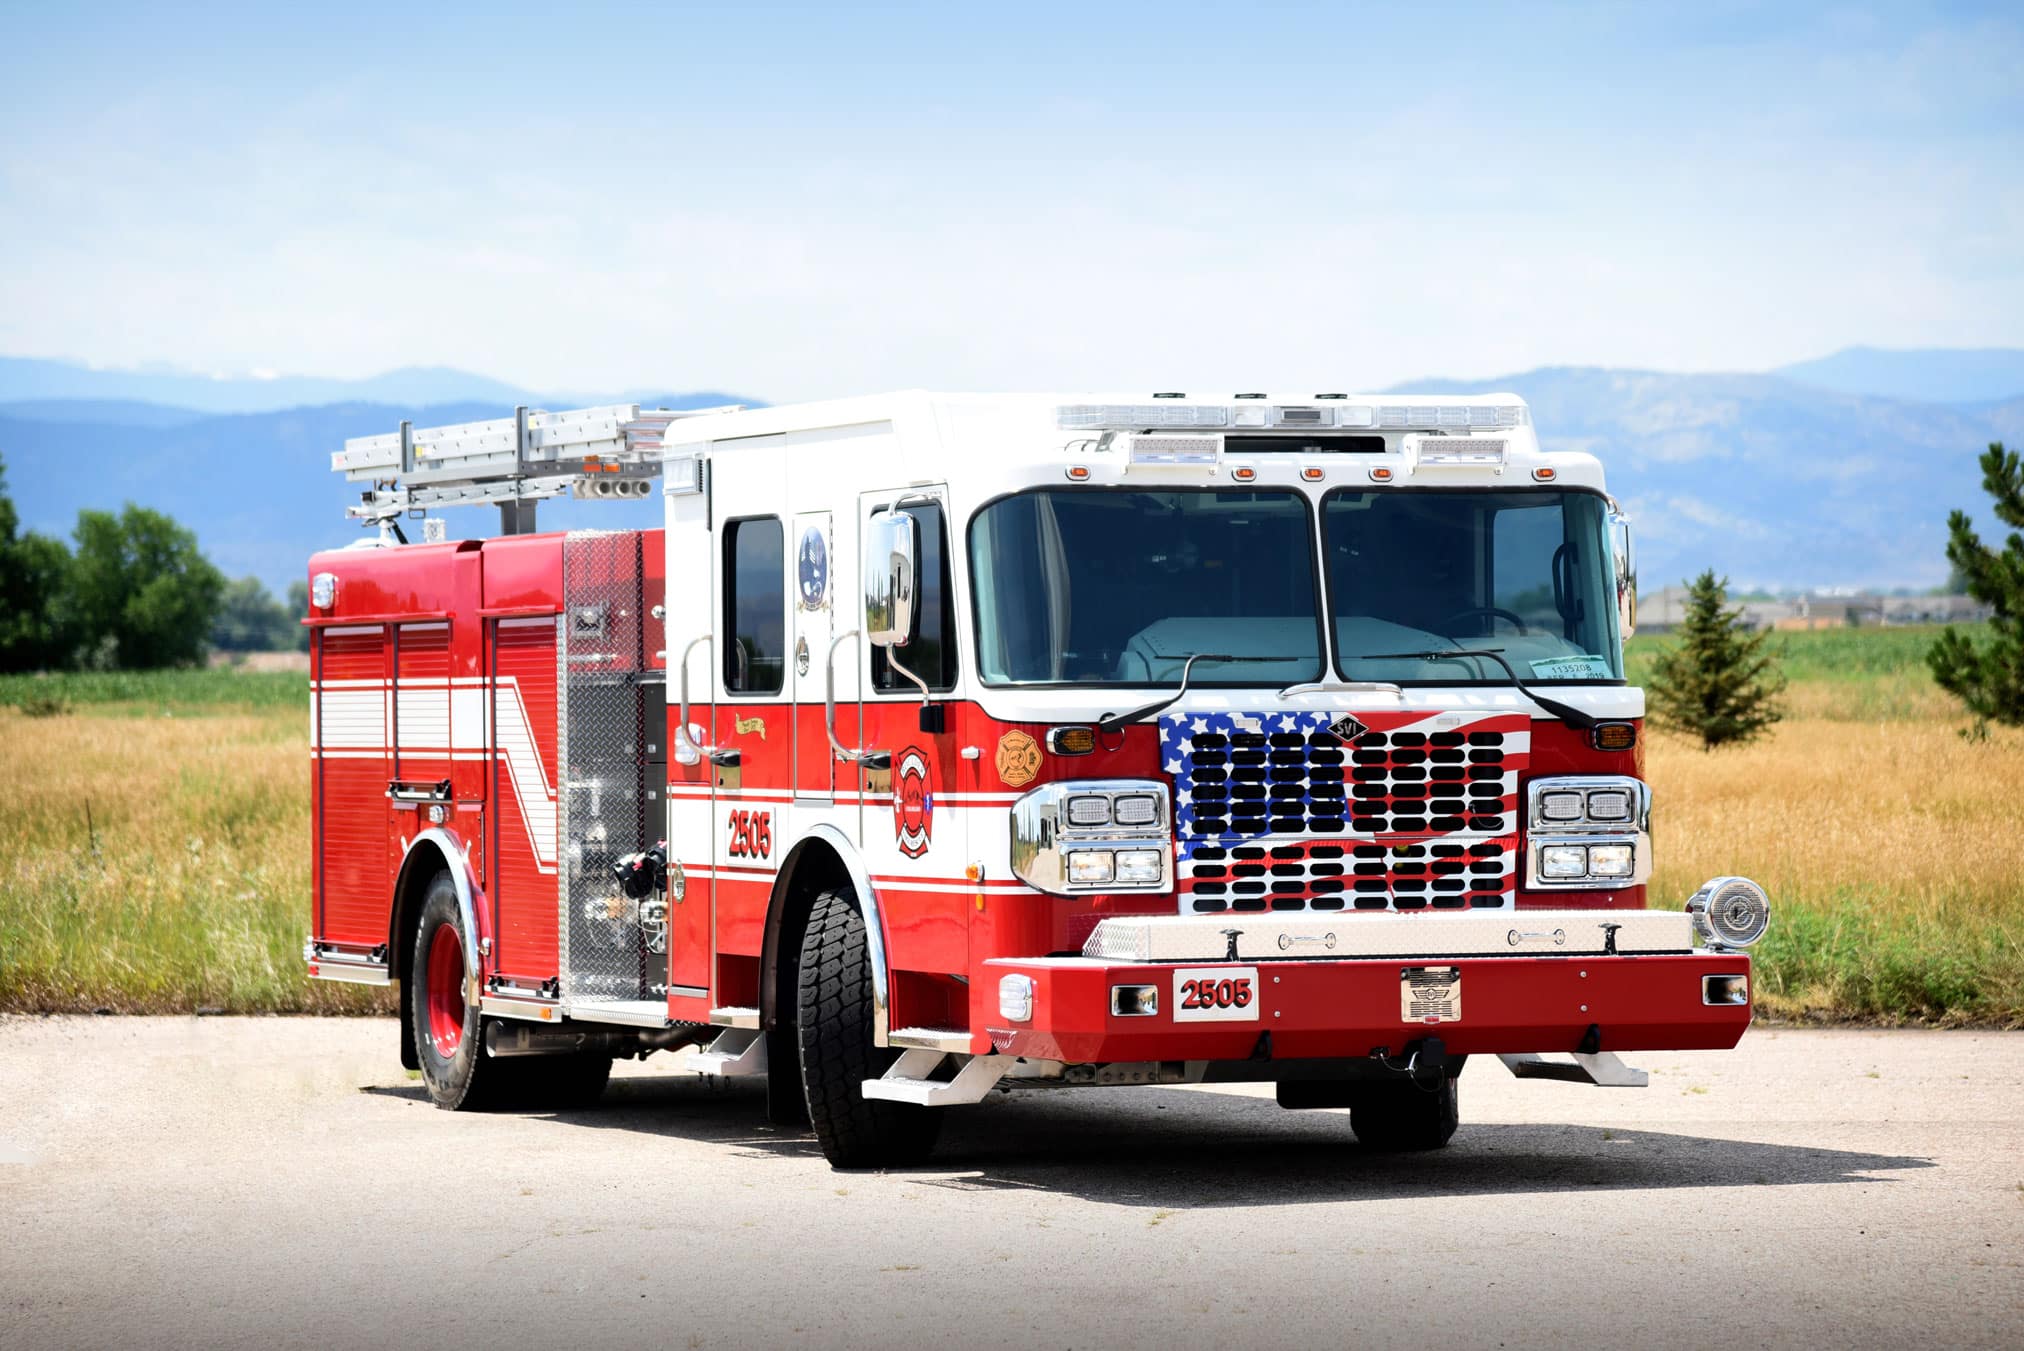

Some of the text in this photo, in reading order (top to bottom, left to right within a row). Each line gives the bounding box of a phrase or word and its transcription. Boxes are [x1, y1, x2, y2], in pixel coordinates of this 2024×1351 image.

[1337, 722, 1357, 735] SVI
[728, 808, 771, 860] 2505
[1180, 978, 1253, 1010] 2505
